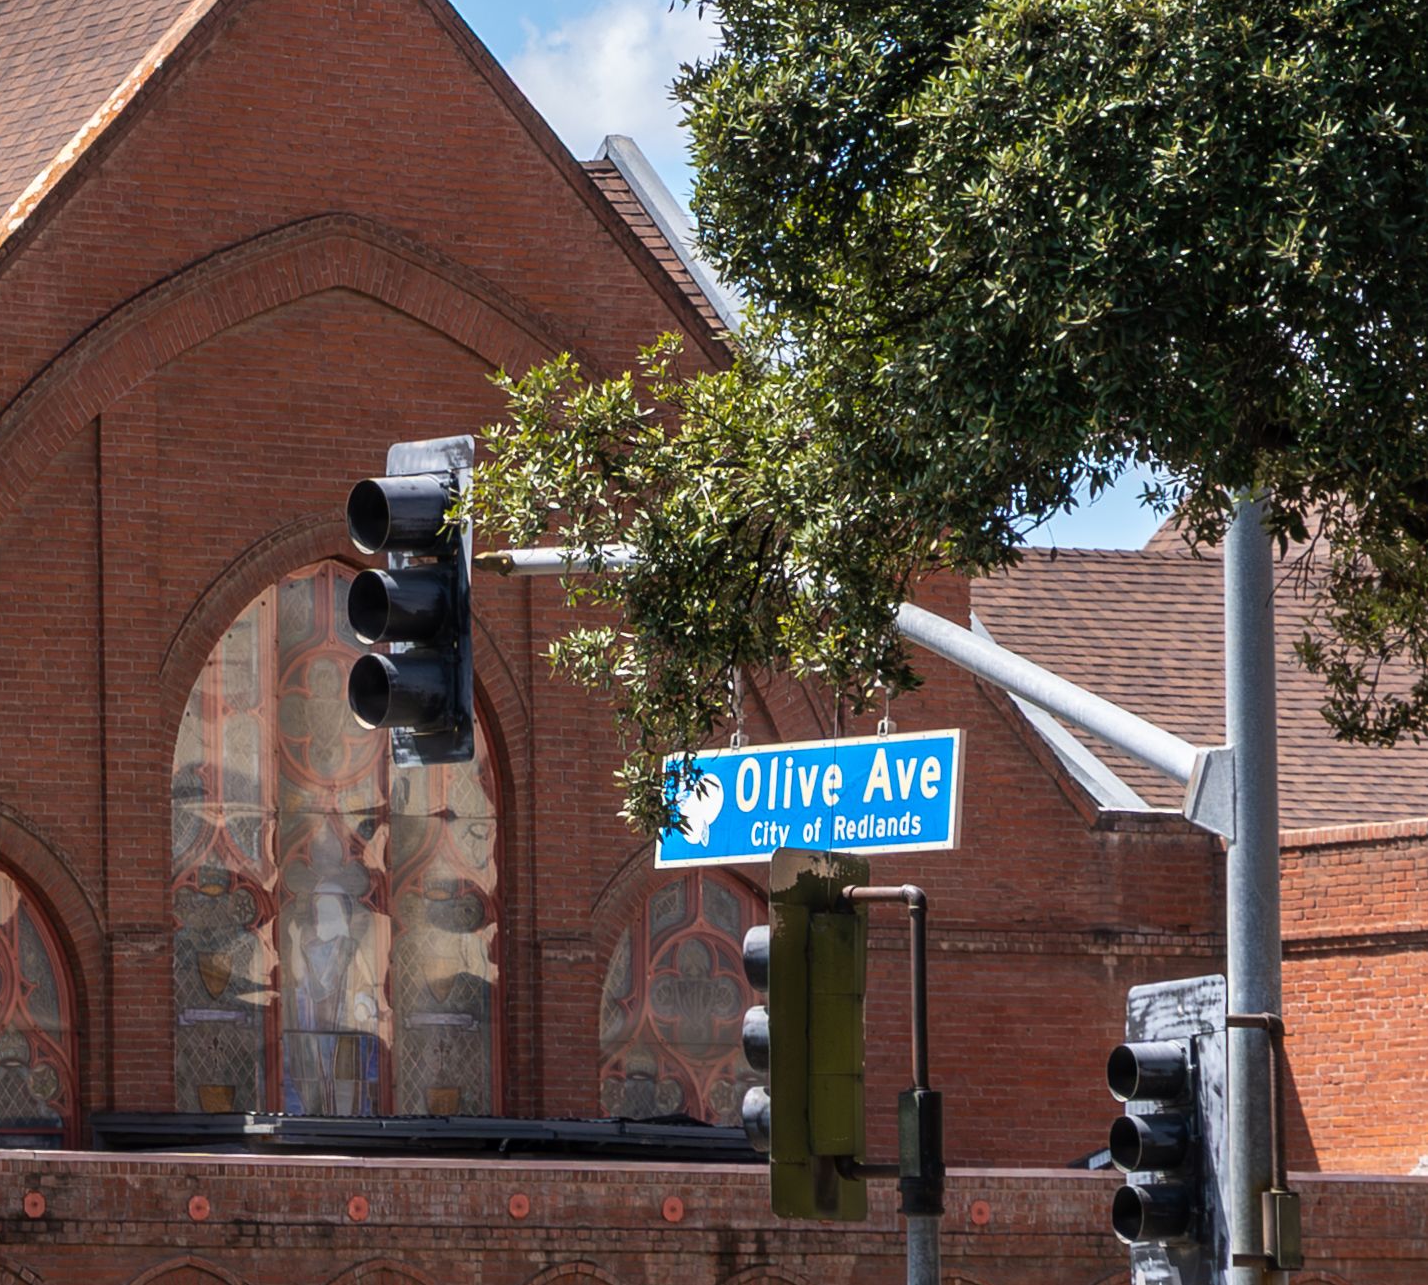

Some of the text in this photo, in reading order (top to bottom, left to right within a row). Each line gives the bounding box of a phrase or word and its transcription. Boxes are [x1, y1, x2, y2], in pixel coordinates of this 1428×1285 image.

[735, 748, 941, 812] Olive Ave
[751, 811, 921, 847] City of Redlands
